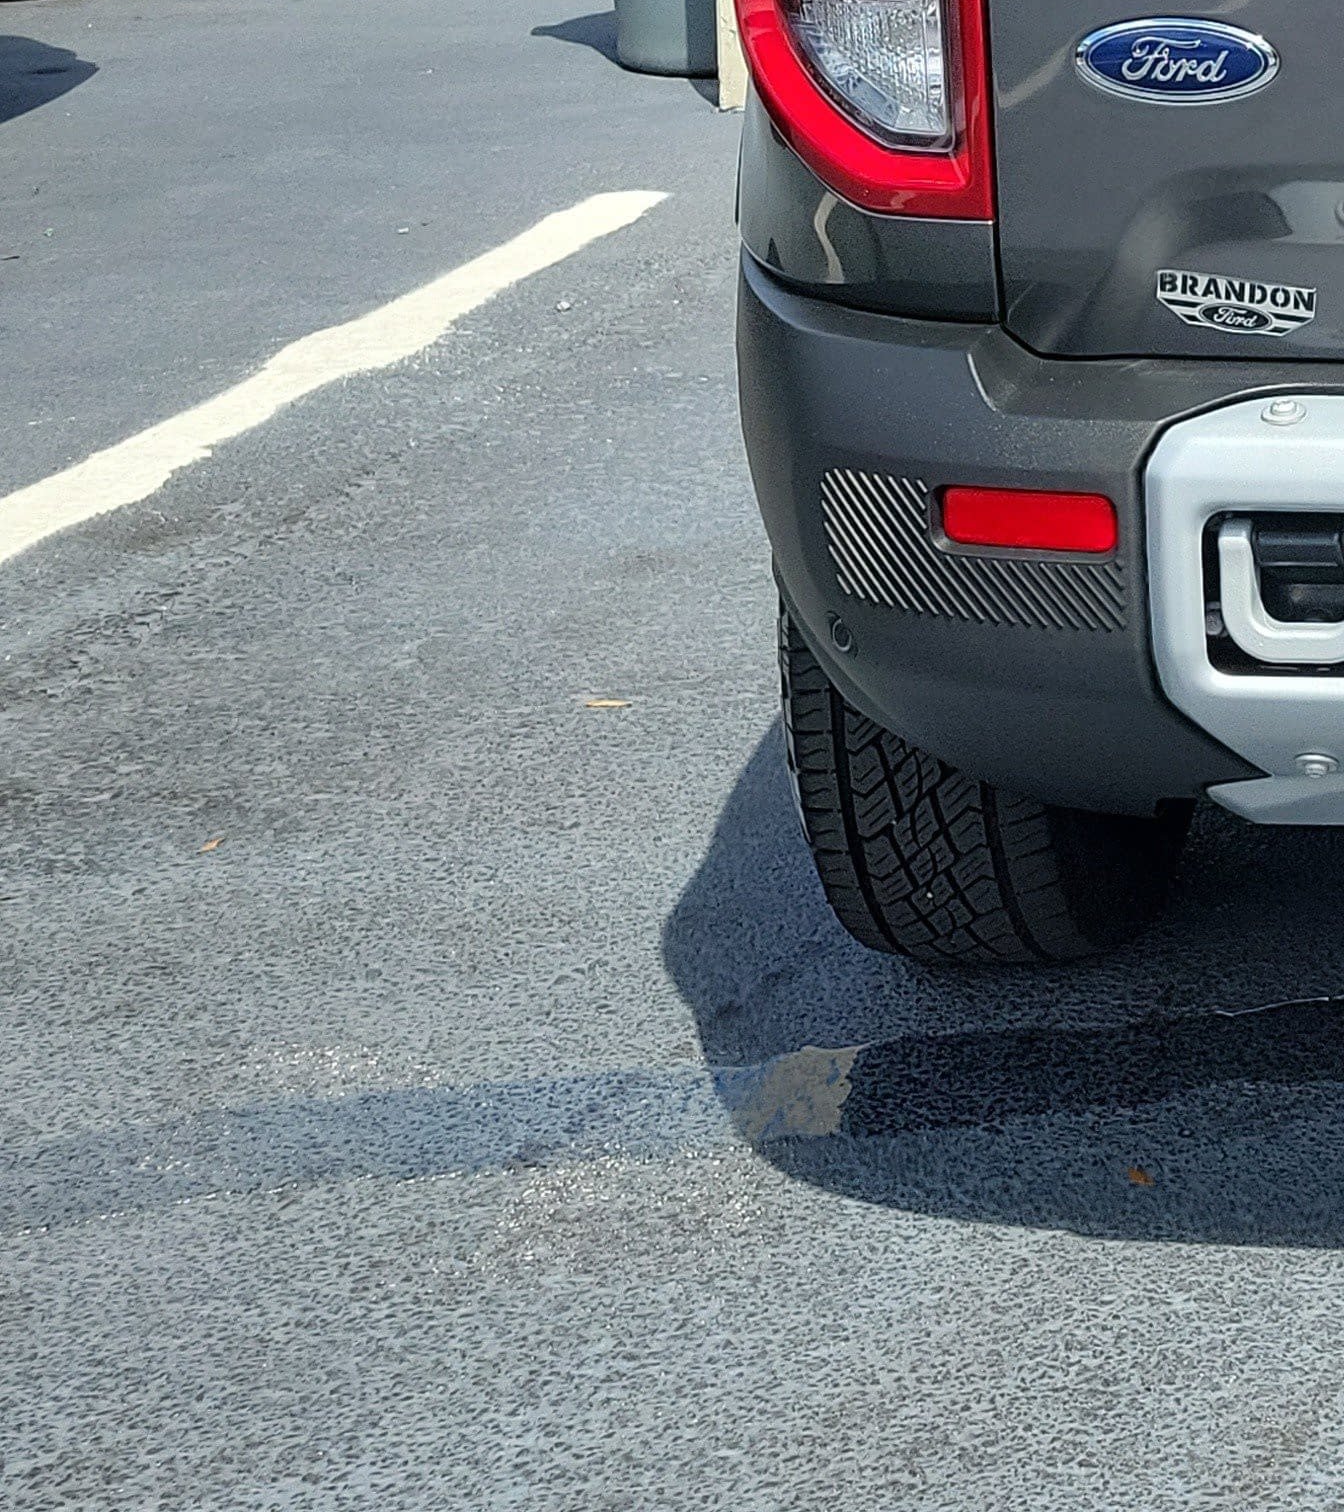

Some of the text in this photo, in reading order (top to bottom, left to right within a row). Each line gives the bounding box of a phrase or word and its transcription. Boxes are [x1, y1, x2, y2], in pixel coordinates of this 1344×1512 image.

[1121, 36, 1229, 83] Ford
[1158, 271, 1316, 313] BRANDON
[1213, 305, 1260, 329] Ford
